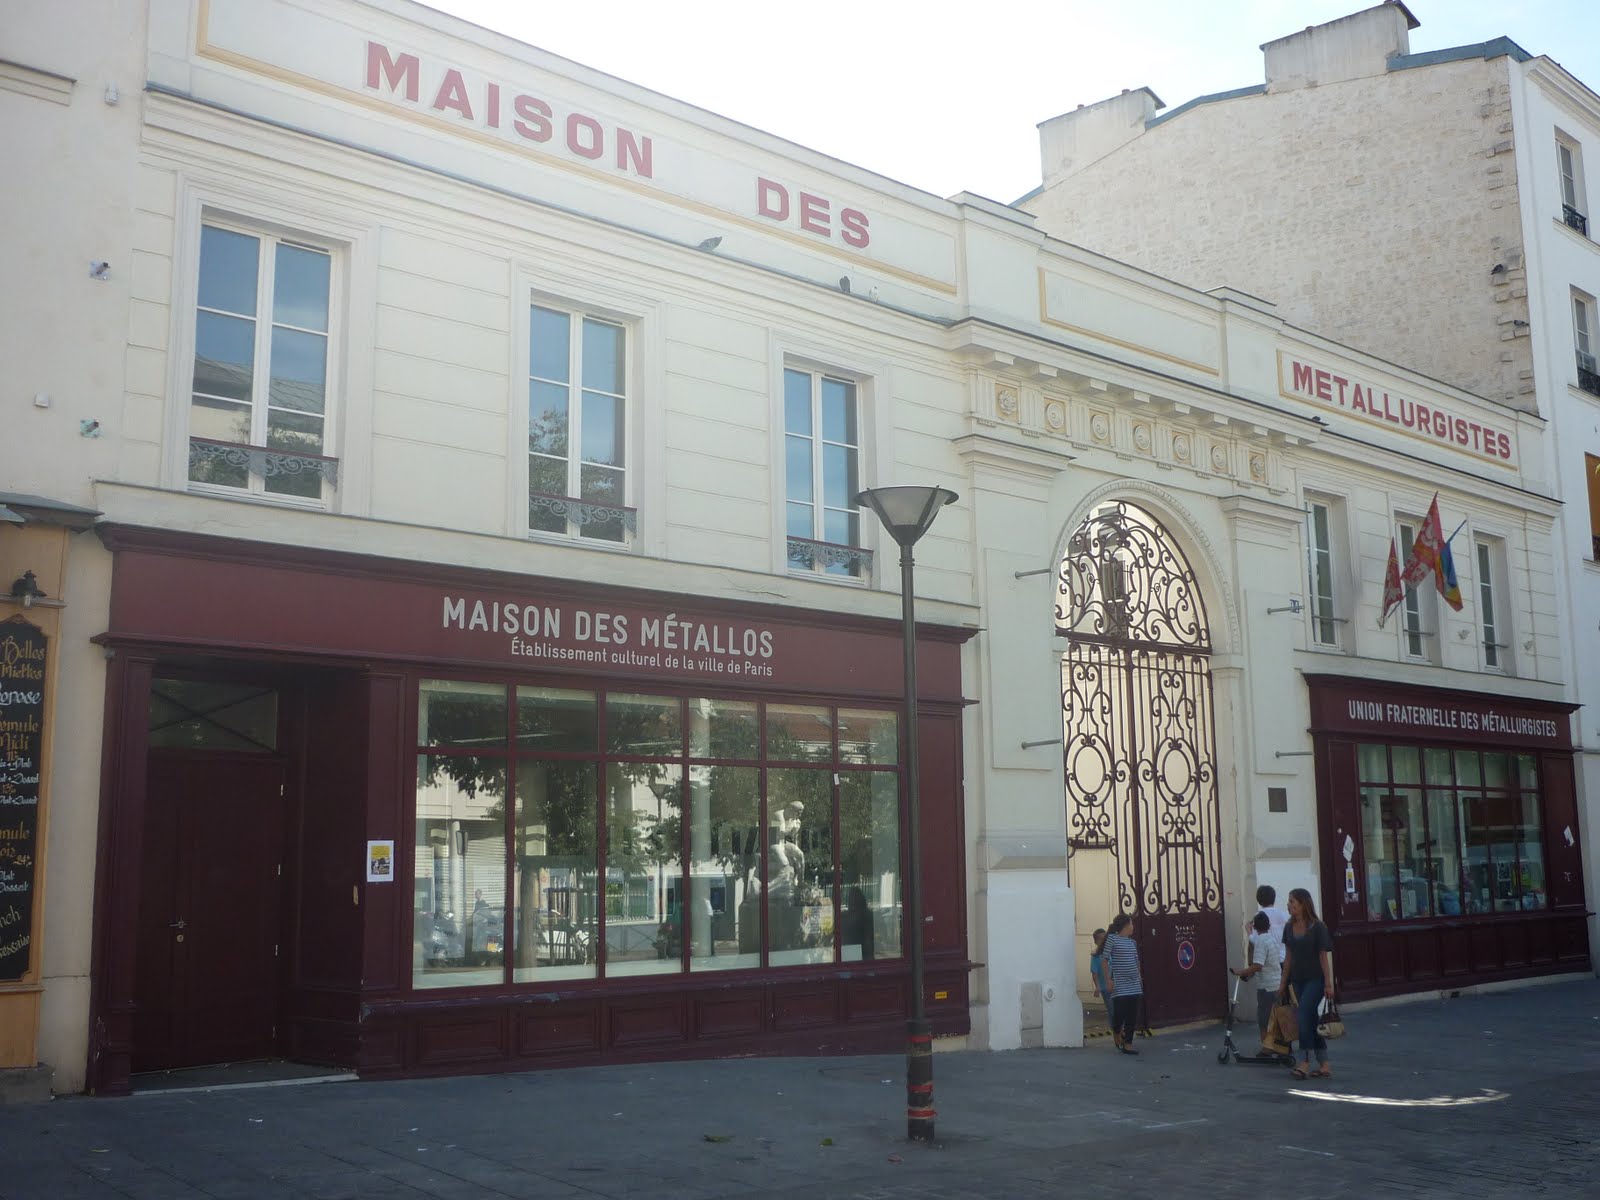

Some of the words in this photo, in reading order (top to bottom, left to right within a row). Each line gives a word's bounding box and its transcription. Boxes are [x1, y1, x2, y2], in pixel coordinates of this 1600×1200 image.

[366, 40, 653, 179] MAISON
[757, 176, 870, 250] DES
[1292, 361, 1511, 459] METALLURGISTES
[443, 596, 560, 638] MAISON
[575, 611, 628, 645] DES
[641, 613, 773, 658] MÉTALLOS
[511, 637, 607, 662] Établissement
[611, 649, 660, 667] culturel
[665, 656, 679, 669] de
[683, 656, 694, 670] la
[698, 658, 723, 672] ville
[728, 661, 741, 673] de
[744, 662, 773, 677] Paris
[1349, 700, 1383, 721] UNION
[1387, 704, 1457, 728] FRATERNELLE
[1461, 711, 1479, 730] DES
[1482, 711, 1557, 736] MÉTALLURGISTES
